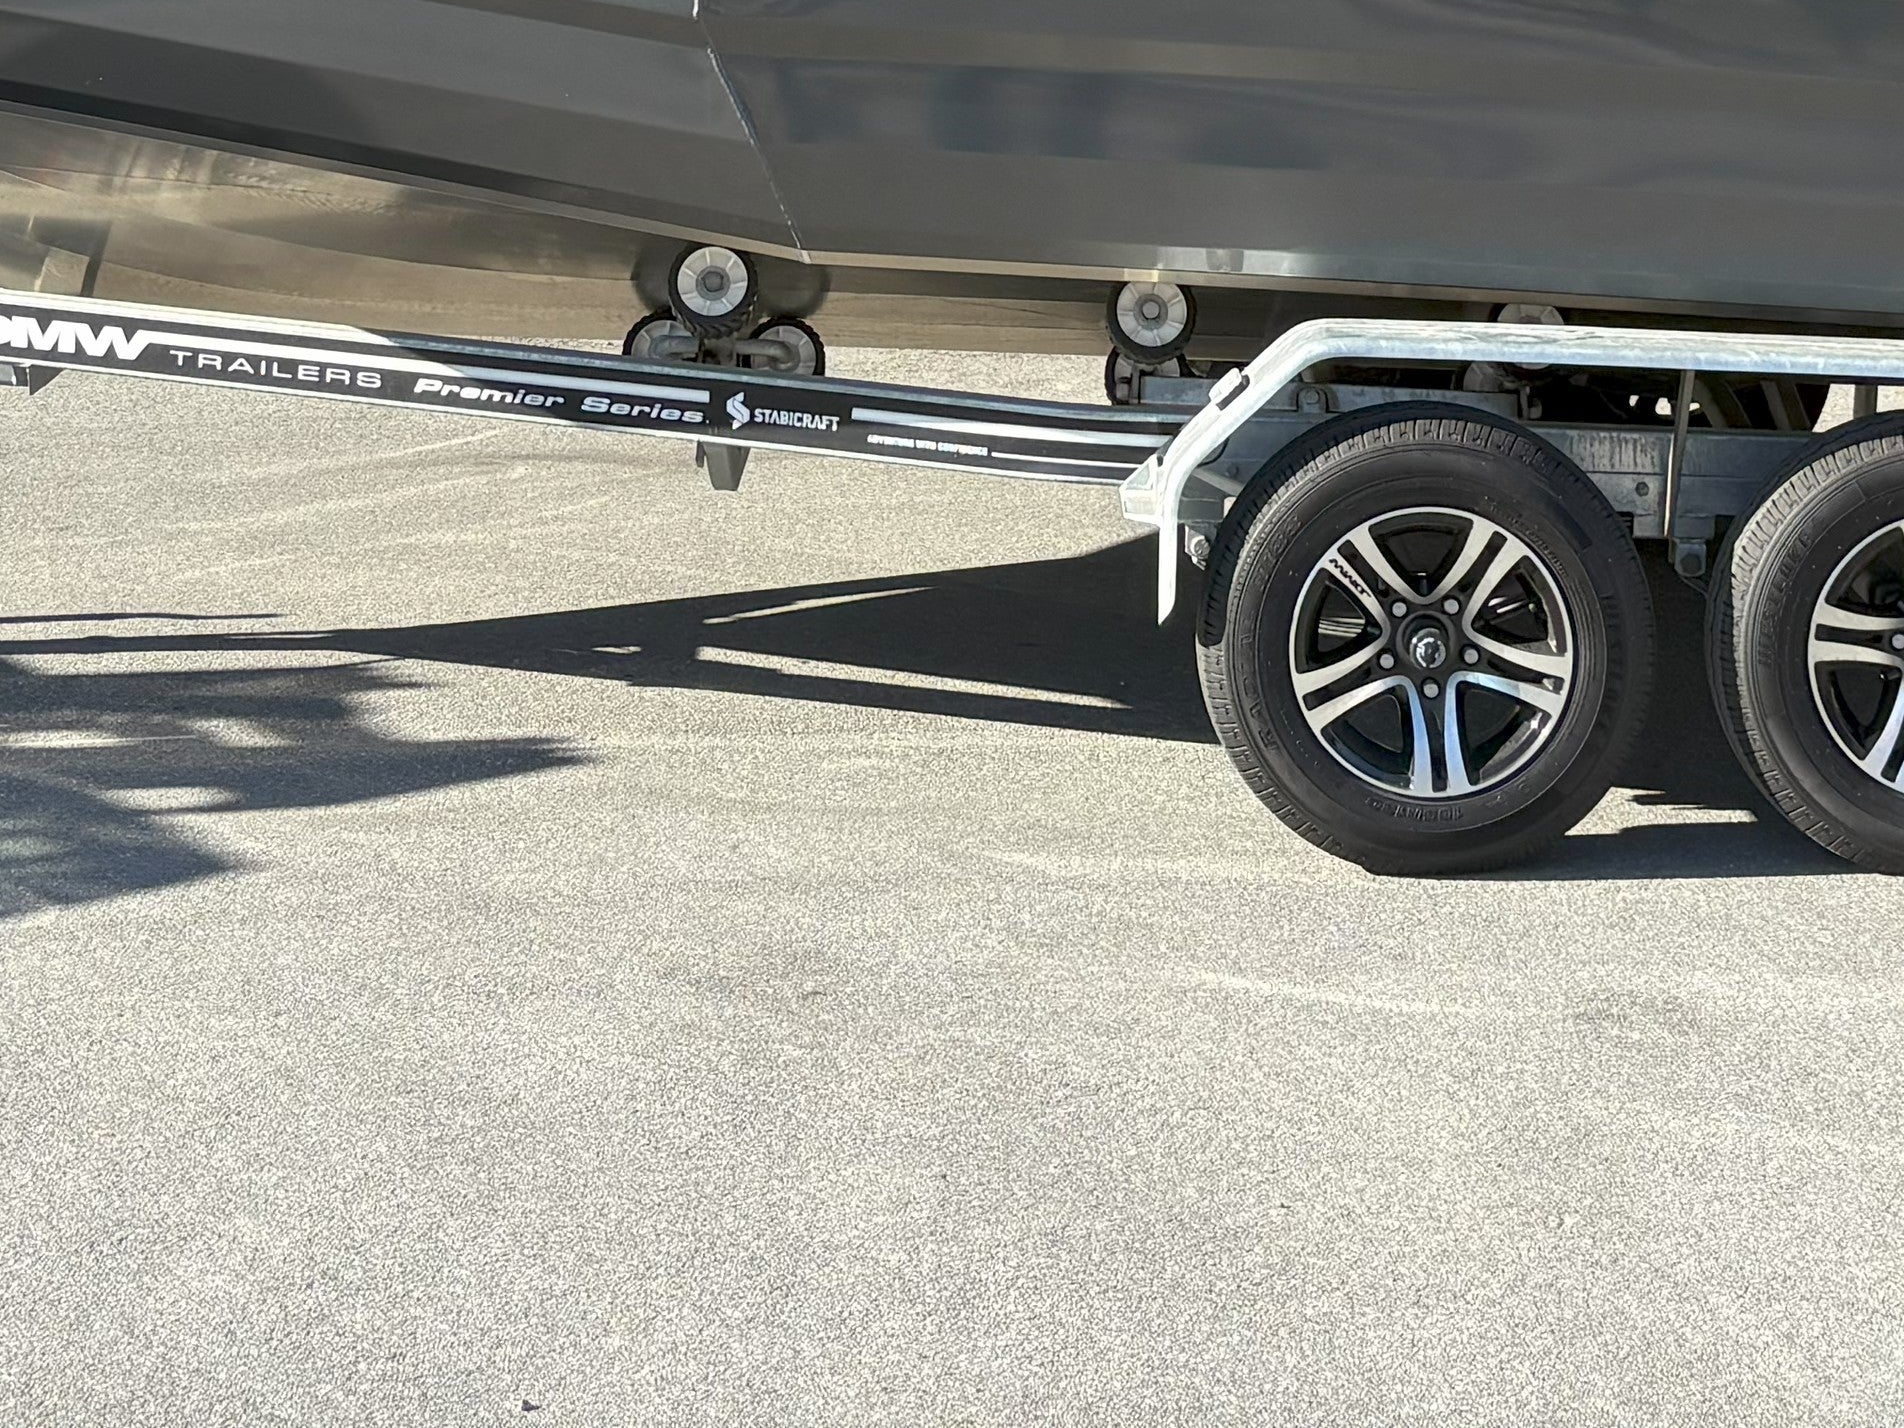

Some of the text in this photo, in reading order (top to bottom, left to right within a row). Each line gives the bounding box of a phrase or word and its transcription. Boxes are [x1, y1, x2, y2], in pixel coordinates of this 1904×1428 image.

[169, 349, 383, 389] TRAILERS
[414, 377, 565, 408] Premier
[754, 408, 840, 432] STABICRAFT
